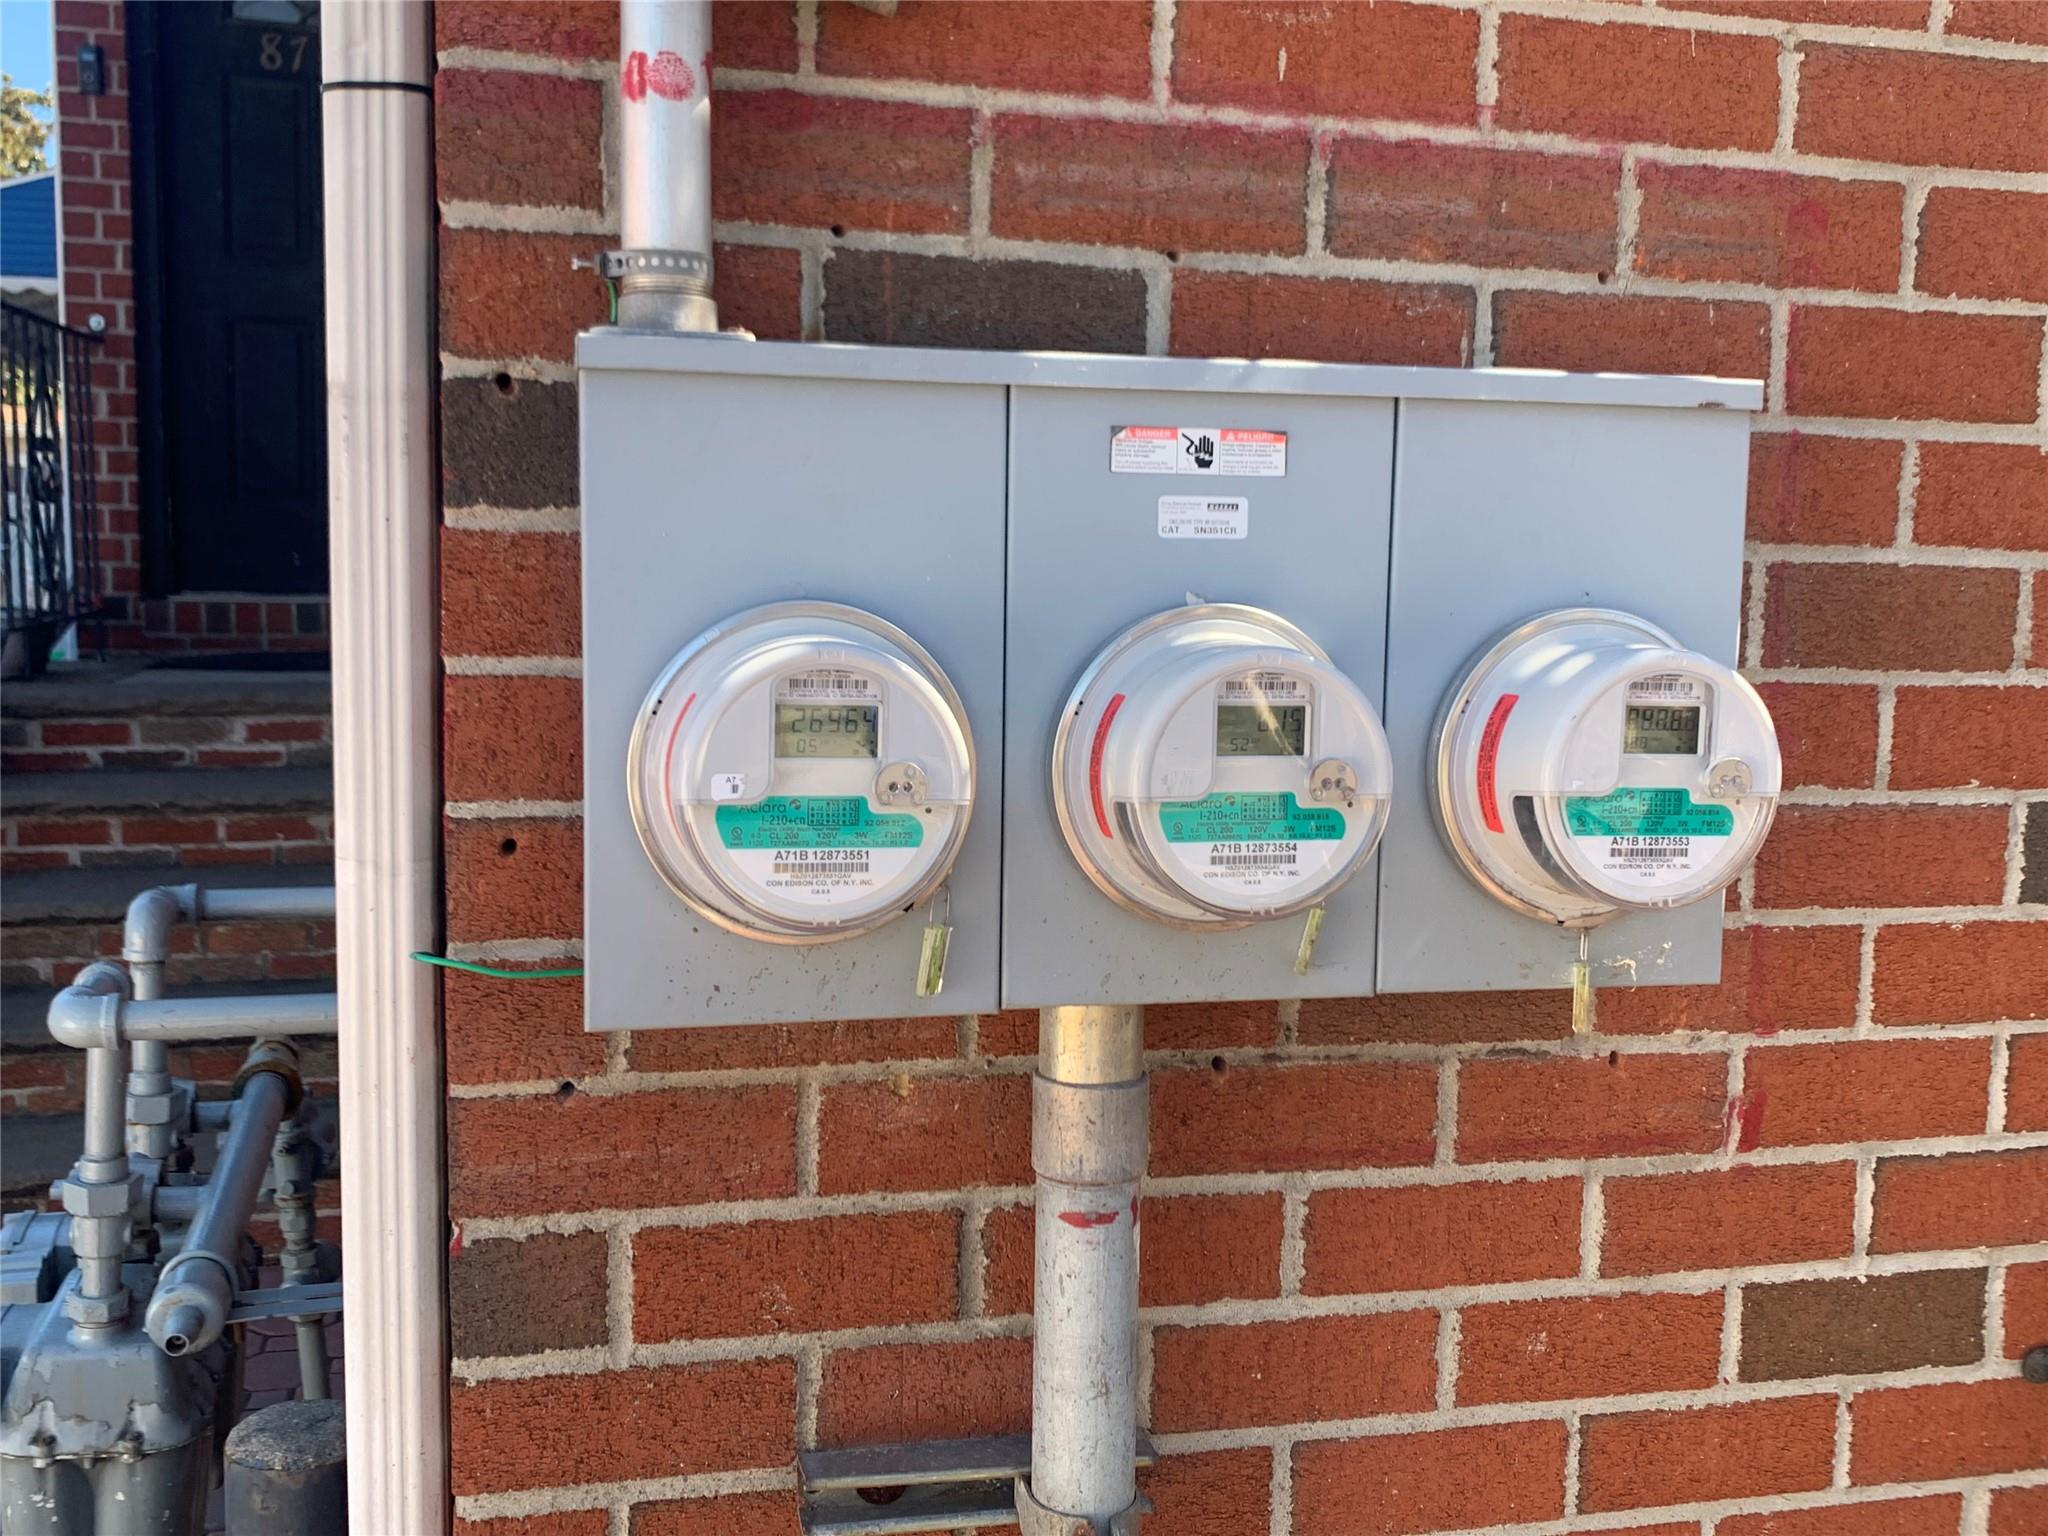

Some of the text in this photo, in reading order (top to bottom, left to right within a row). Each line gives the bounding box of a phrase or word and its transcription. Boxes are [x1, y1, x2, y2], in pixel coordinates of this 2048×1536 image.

[260, 32, 308, 72] 87
[1136, 427, 1171, 437] DANGER
[739, 801, 786, 814] Aclara
[1206, 826, 1217, 834] CL
[1220, 826, 1233, 834] 200
[1250, 825, 1267, 833] 120V
[769, 832, 779, 840] CL
[784, 832, 799, 840] 200
[1611, 837, 1690, 846] A71B 12873553
[1211, 843, 1297, 853] A71B 12873554
[774, 850, 869, 860] A71B 12873551
